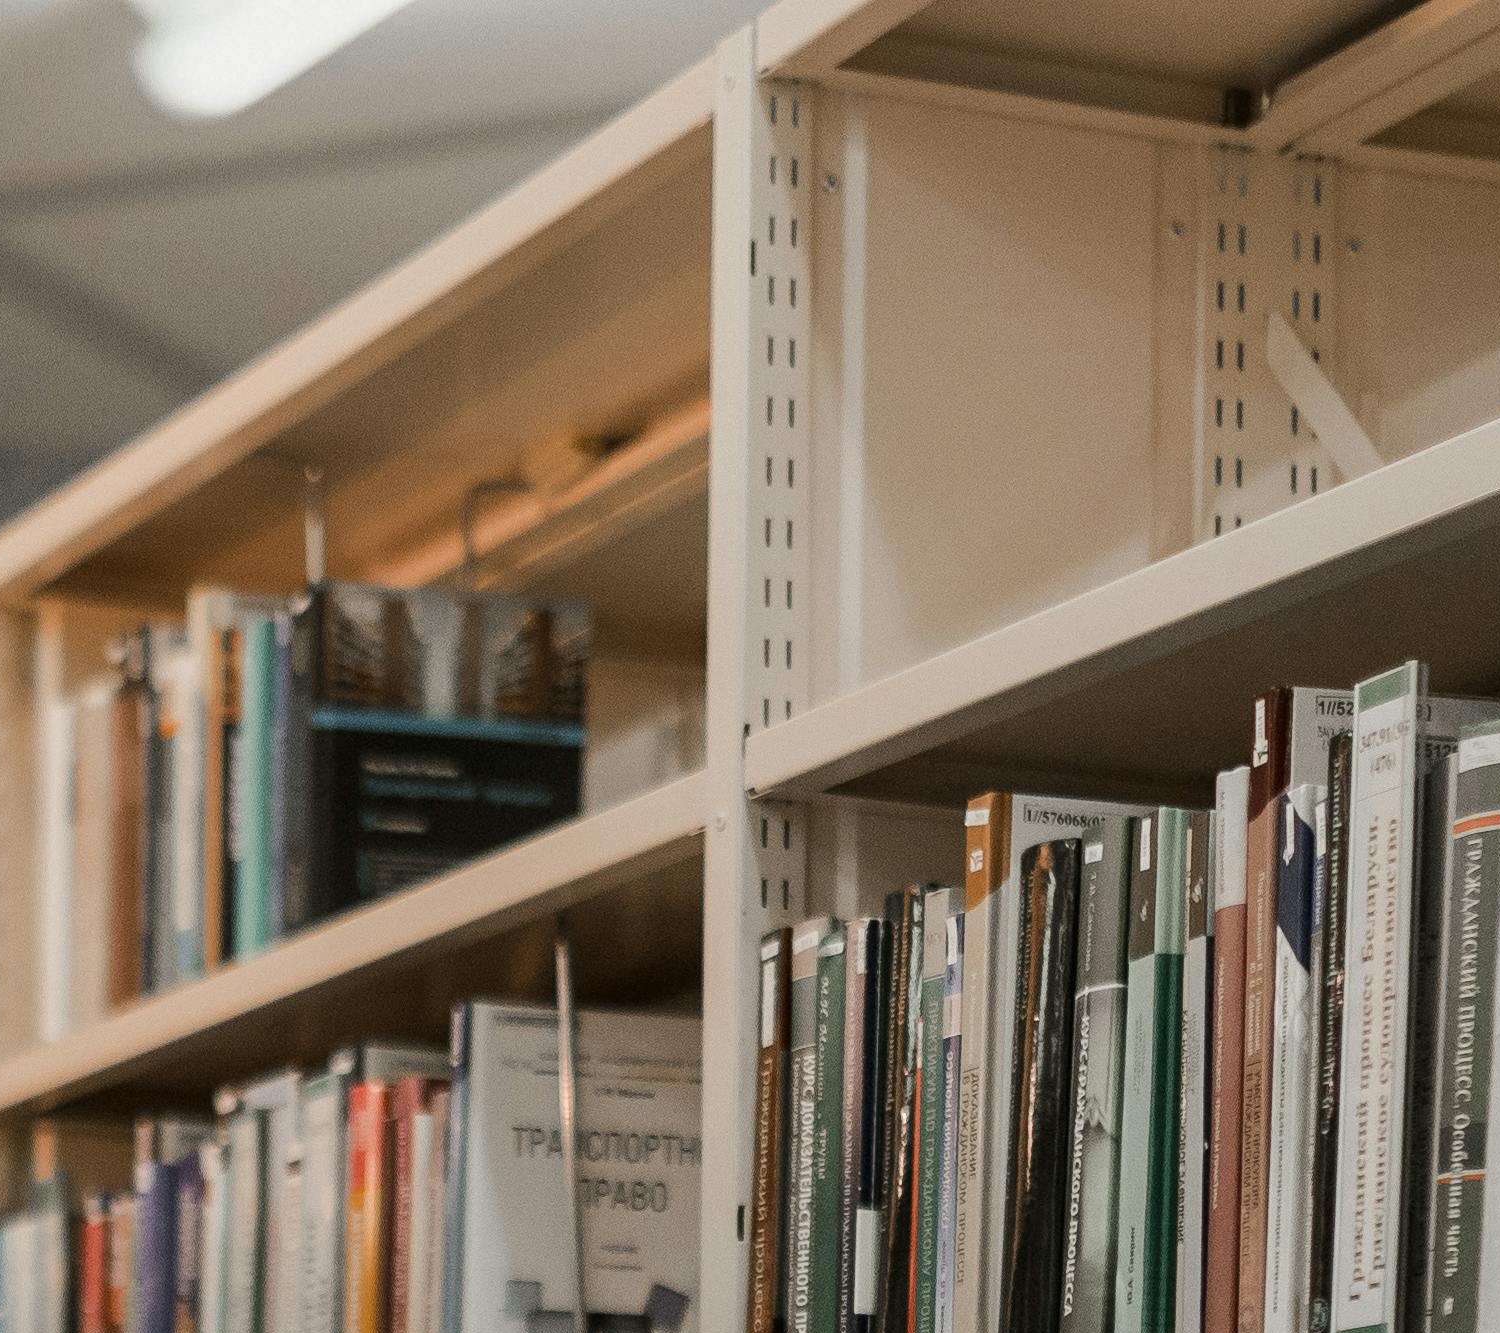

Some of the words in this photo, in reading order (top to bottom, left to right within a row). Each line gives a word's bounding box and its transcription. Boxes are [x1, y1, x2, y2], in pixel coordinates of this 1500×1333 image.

[1361, 815, 1378, 964] Беларуси.
[1458, 837, 1483, 1000] ГРАЖДАНСКИЙ
[803, 1055, 816, 1097] КУРС
[926, 999, 939, 1104] ПРАКТИКУМ
[1360, 972, 1371, 1090] процесс
[1369, 1094, 1388, 1290] Гражданское
[1379, 817, 1397, 1085] судопроизводство
[1454, 1004, 1474, 1108] ПРОЦЕСС.
[512, 1127, 701, 1166] ТРАСПОРТН
[758, 1057, 772, 1222] Гражданский
[926, 1109, 936, 1133] ПО
[1070, 1064, 1086, 1216] ГРАЖДАНСКОГО
[578, 1178, 669, 1213] ПРАВО
[796, 1100, 814, 1306] ДОКАЗАТЕЛЬСТВЕННОГО
[922, 1136, 935, 1276] ГРАЖДАНСКОМУ
[1349, 1101, 1368, 1303] Гражданский
[1444, 1224, 1461, 1278] часть
[755, 1226, 768, 1333] процесс
